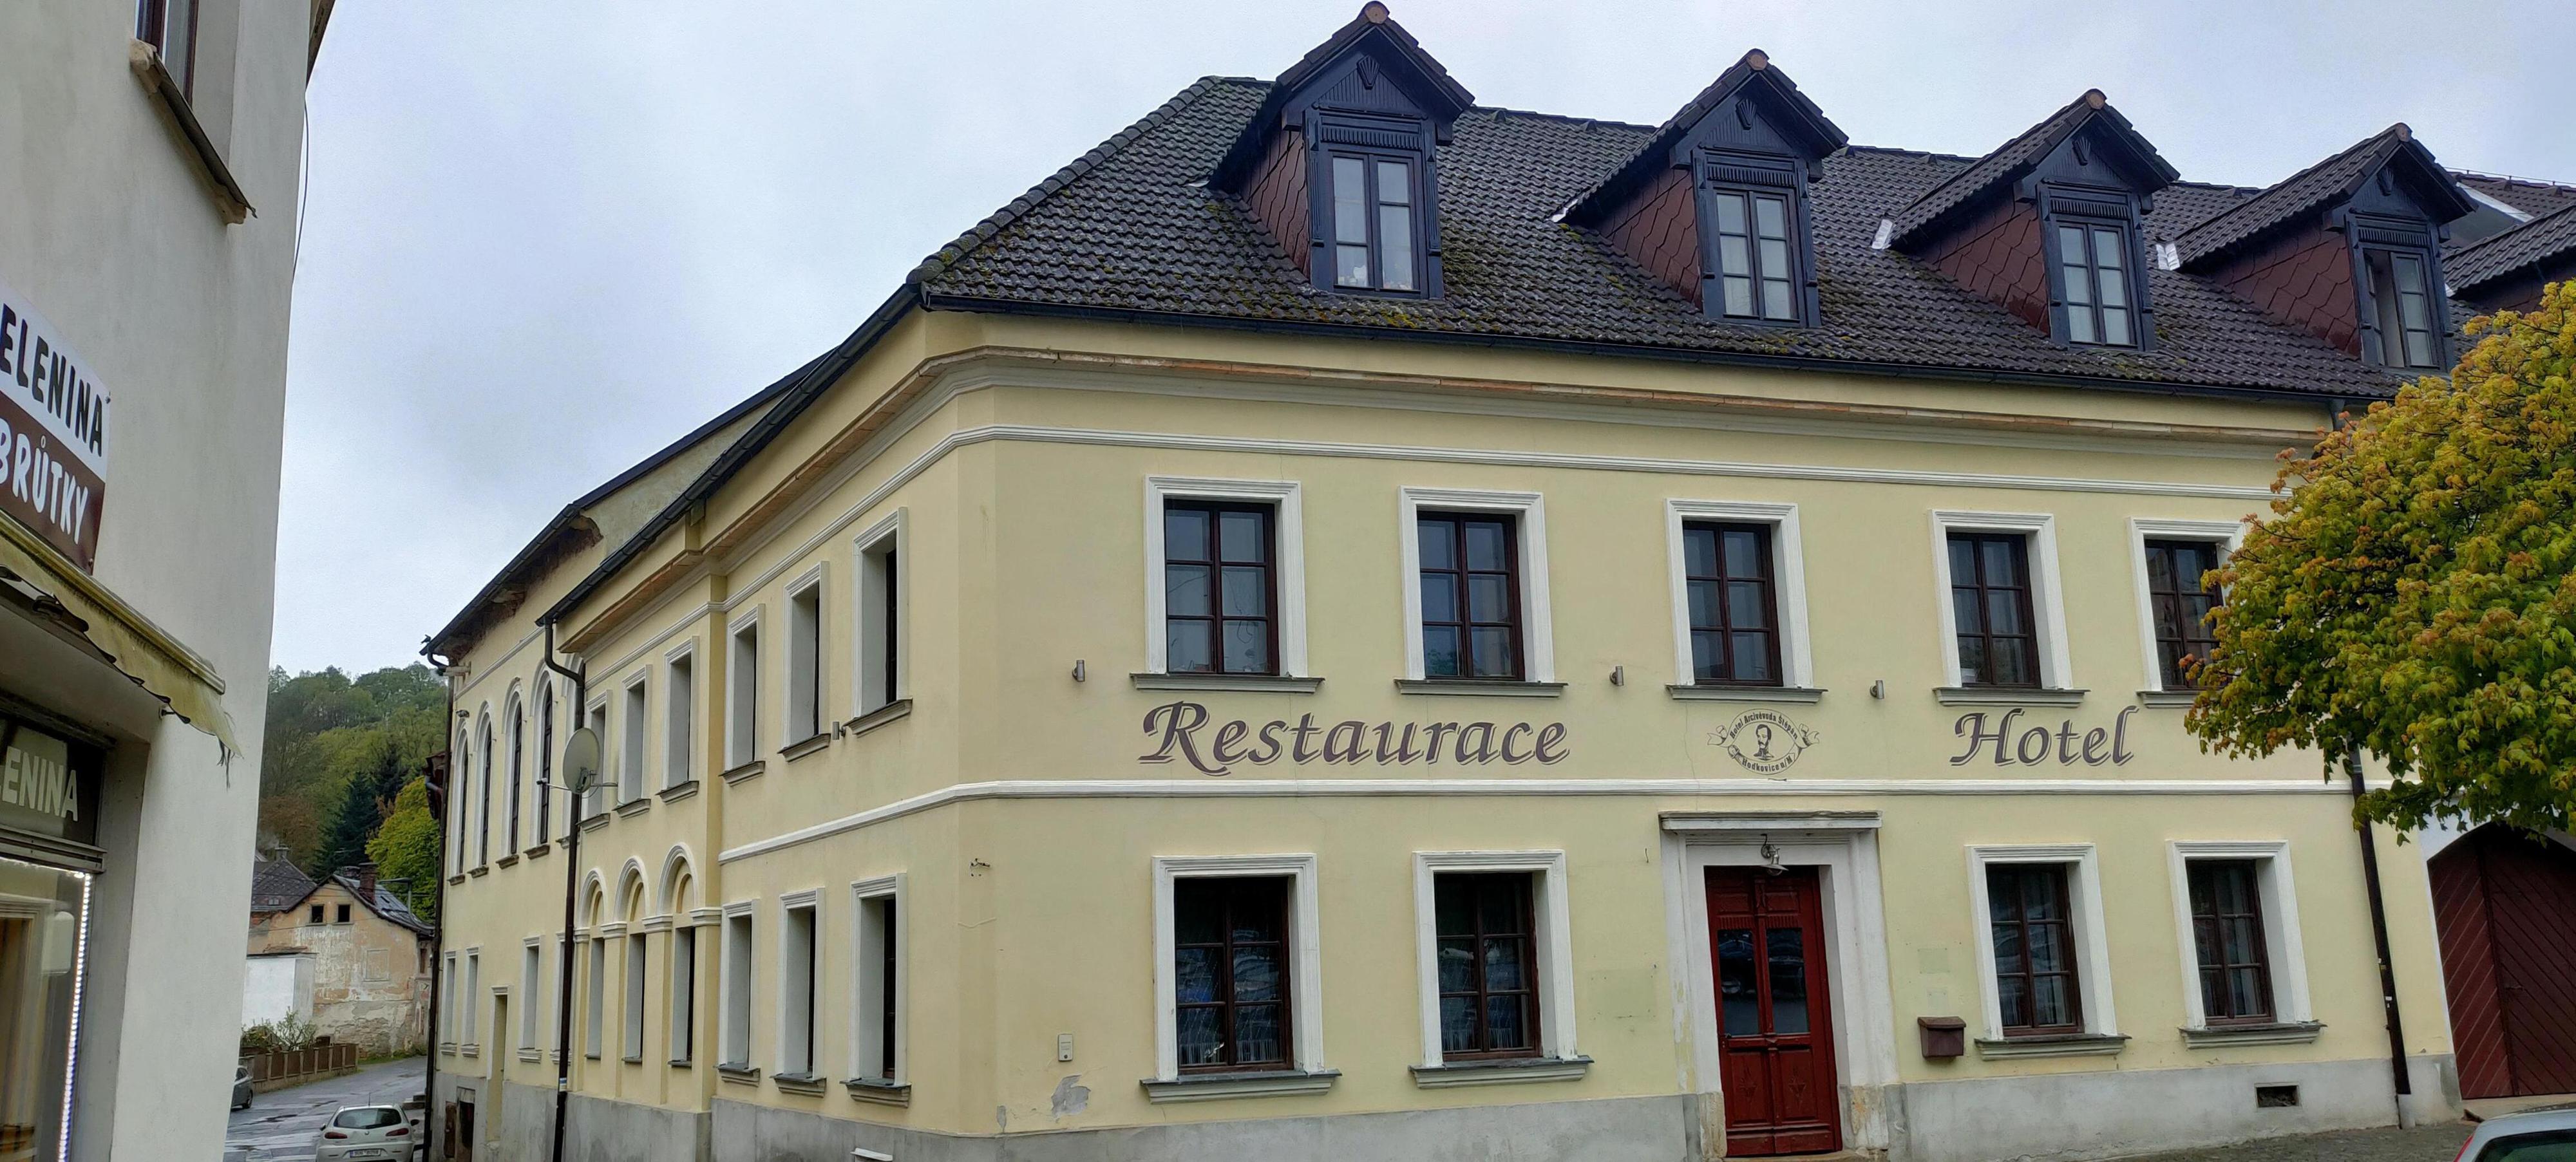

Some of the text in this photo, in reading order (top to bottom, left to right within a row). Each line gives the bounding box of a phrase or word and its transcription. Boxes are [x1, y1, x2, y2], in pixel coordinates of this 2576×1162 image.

[0, 303, 102, 457] ELENINA
[1137, 700, 1569, 776] Restaurace
[1730, 718, 1743, 739] Hotel
[1949, 706, 2139, 767] Hotel
[0, 745, 78, 821] ENINA
[1742, 758, 1779, 772] Hodkovice
